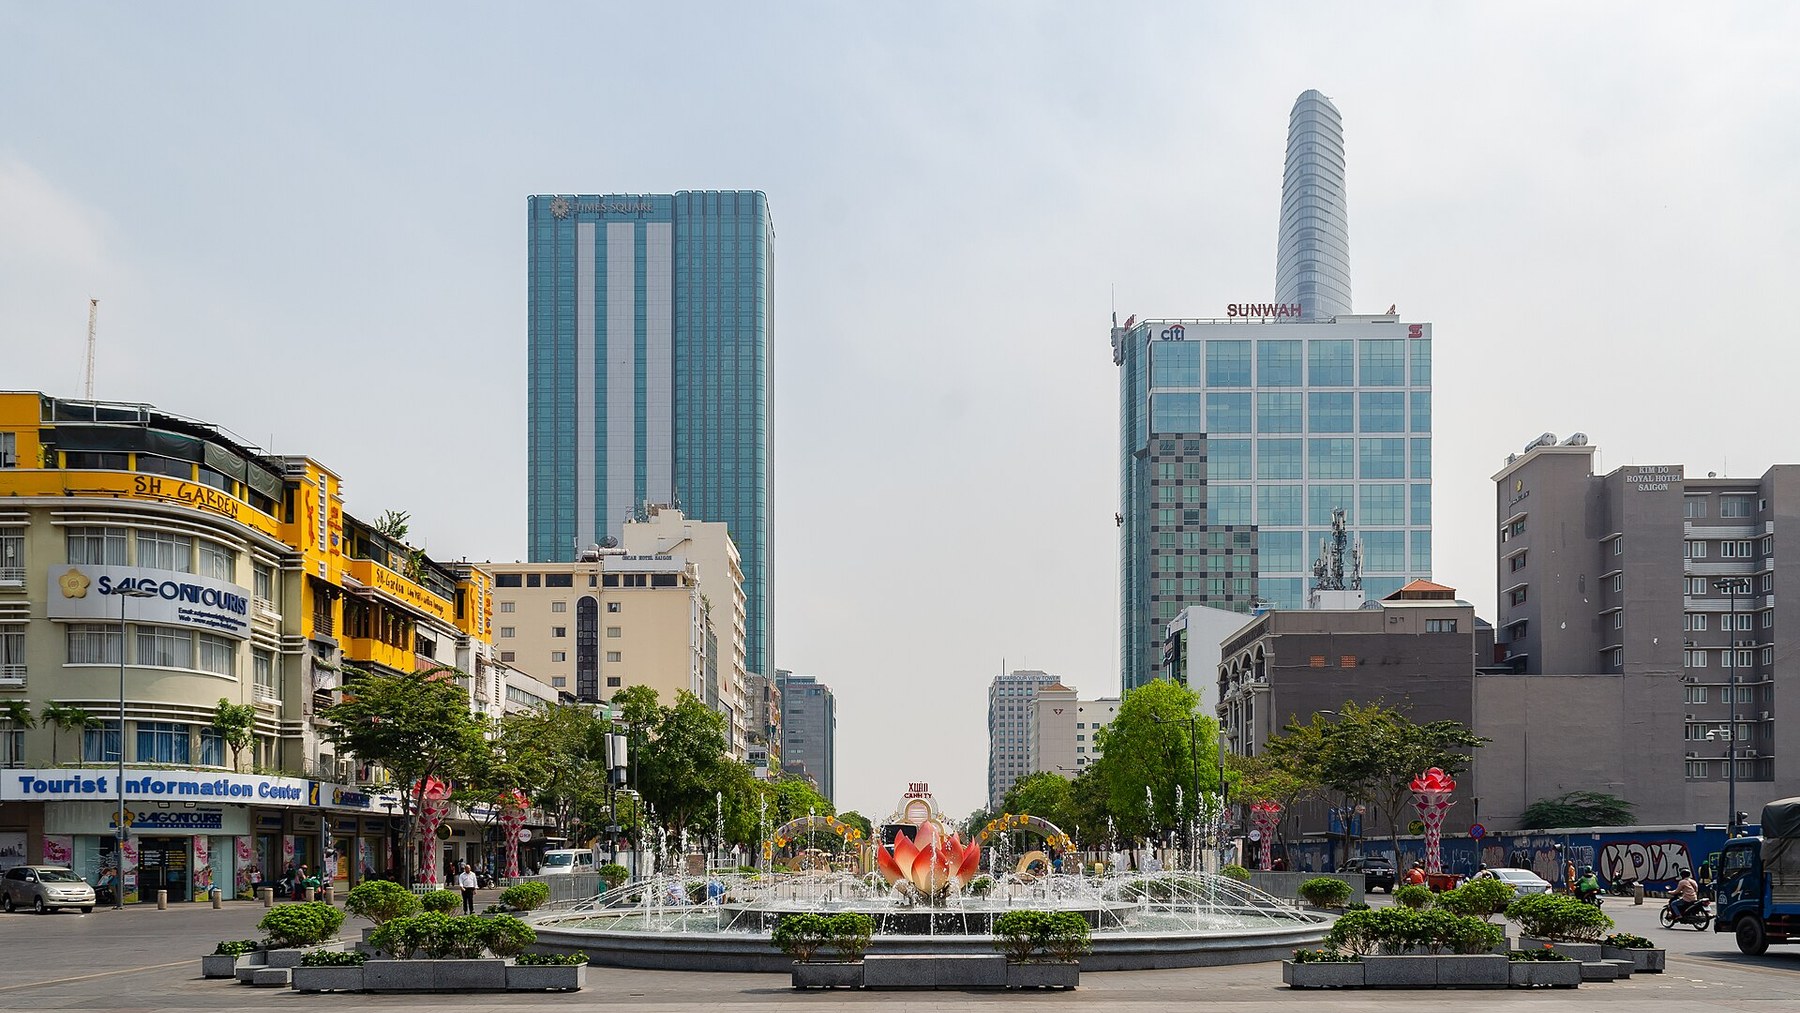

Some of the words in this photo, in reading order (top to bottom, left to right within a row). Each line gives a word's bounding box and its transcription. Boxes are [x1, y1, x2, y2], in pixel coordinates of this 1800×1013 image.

[575, 203, 607, 212] TIMES
[610, 203, 653, 214] SQUARE
[1227, 303, 1302, 317] SUNWAH
[1161, 324, 1185, 341] citi
[1639, 466, 1655, 474] KIM
[1657, 466, 1669, 474] DO
[1626, 475, 1654, 483] ROYAL
[1638, 484, 1669, 492] SAIGON
[134, 476, 161, 493] SH
[178, 482, 239, 515] GARDEN
[97, 575, 248, 615] SAIGONTOURIST
[19, 775, 108, 794] Tourist
[258, 781, 303, 801] Center
[137, 812, 223, 824] SAIGONTOURIST
